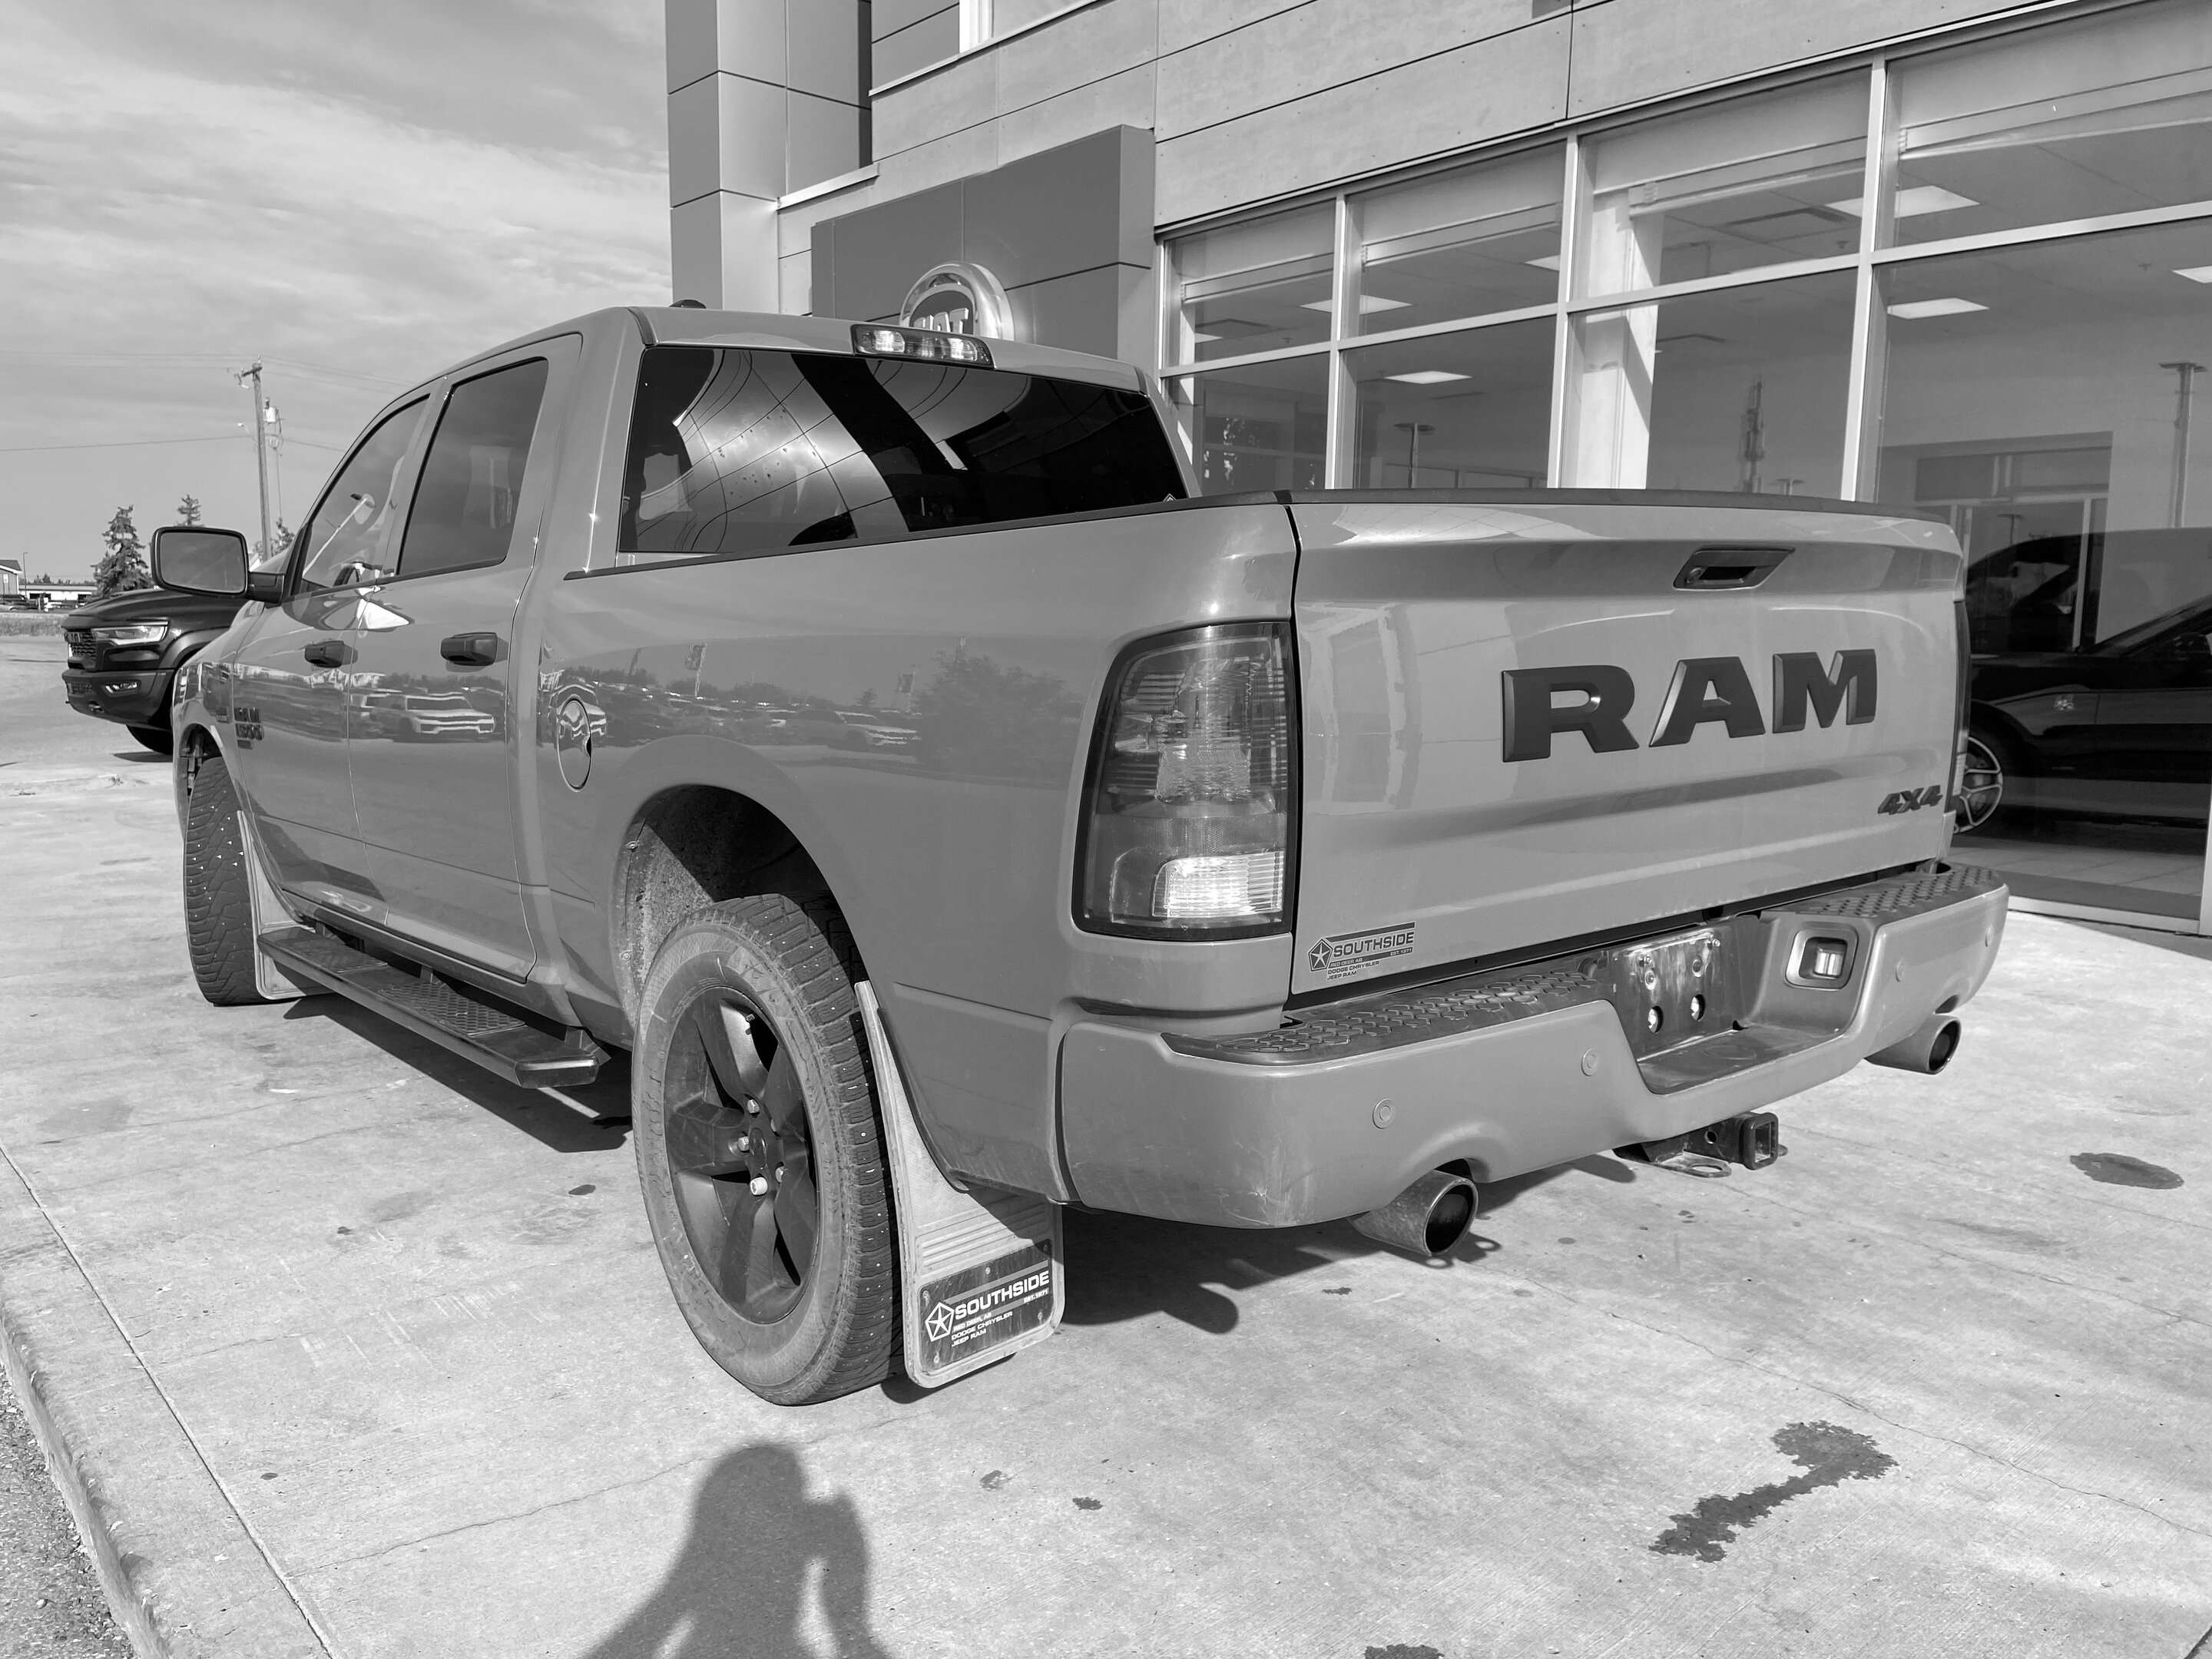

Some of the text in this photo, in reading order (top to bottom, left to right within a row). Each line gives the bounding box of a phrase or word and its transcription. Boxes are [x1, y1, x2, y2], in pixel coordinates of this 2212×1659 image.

[1501, 648, 1878, 763] RAM
[1877, 784, 1943, 815] 4X4
[1333, 932, 1415, 958] SOUTHSIDE
[1328, 961, 1380, 975] DODGE CHRYSLER
[955, 1270, 1050, 1320] SOUTHSIDE
[952, 1311, 1013, 1341] DODGE CHRYSLER
[952, 1329, 988, 1347] JEEP RAM
